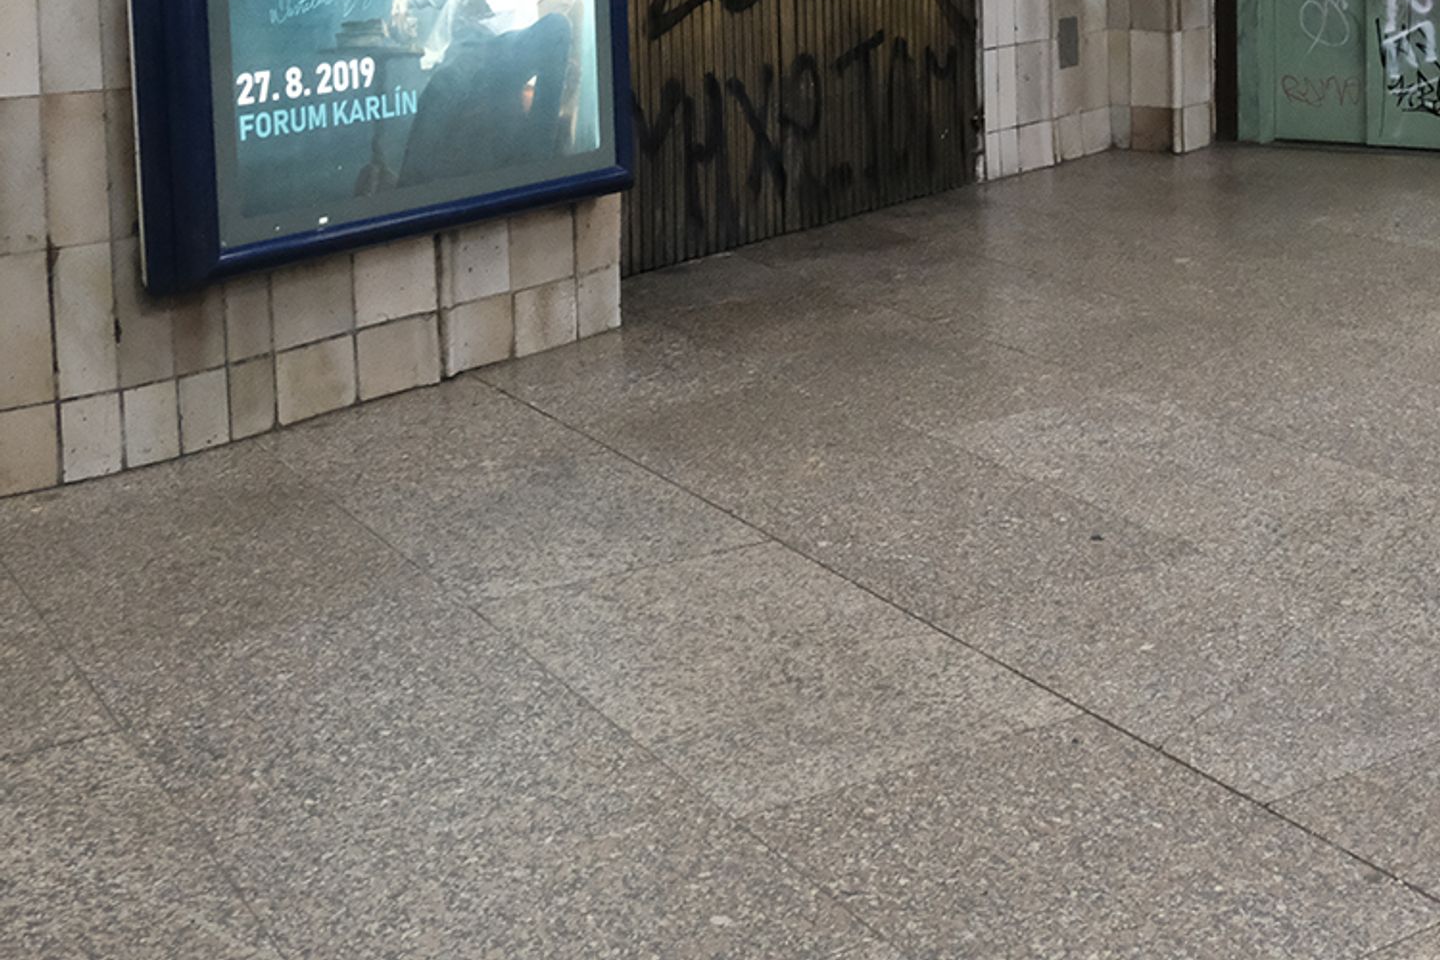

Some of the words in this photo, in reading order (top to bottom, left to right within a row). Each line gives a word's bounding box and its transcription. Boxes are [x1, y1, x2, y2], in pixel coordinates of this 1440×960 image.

[235, 71, 280, 107] 27.
[284, 66, 312, 100] 8.
[315, 56, 376, 96] 2019
[239, 102, 327, 141] FORUM
[332, 85, 418, 128] KARLÍN
